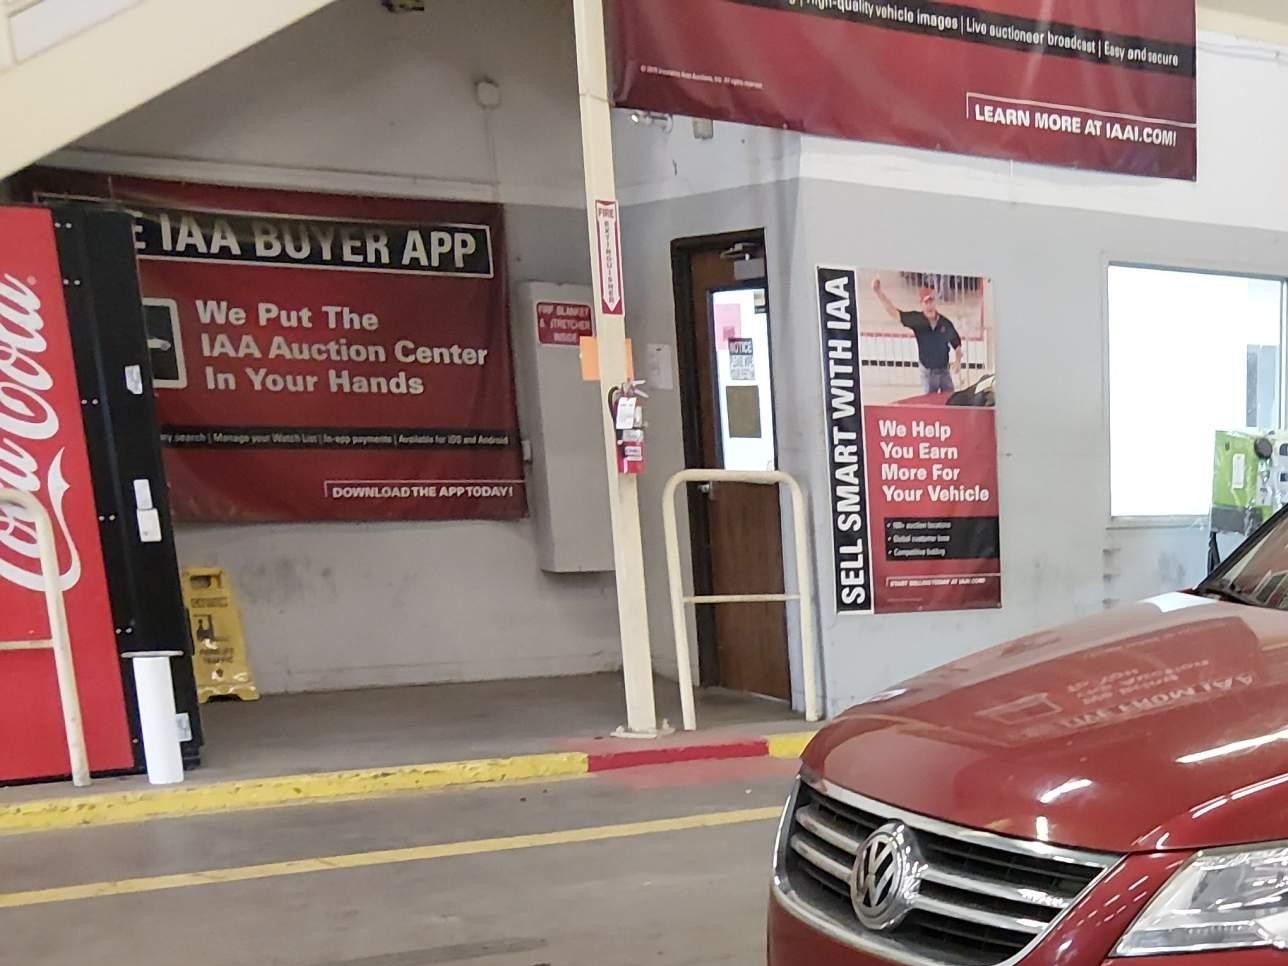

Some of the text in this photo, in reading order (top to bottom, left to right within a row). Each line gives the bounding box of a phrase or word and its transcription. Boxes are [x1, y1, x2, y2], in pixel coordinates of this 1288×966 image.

[876, 4, 914, 24] vehicle
[917, 9, 958, 31] images
[966, 17, 987, 35] Live
[989, 24, 1045, 46] auctioneer
[1047, 30, 1096, 54] broadcast
[1104, 41, 1125, 62] Easy
[1127, 46, 1147, 62] and
[1148, 50, 1179, 67] secure
[975, 103, 1177, 147] LEARN MORE AT IAAI.COM!
[160, 213, 242, 256] IAA
[251, 218, 391, 265] BUYER
[401, 229, 477, 269] APP
[195, 299, 379, 331] We Put The
[201, 332, 488, 367] IAA Auction Center
[205, 366, 424, 396] In Your Hands
[824, 275, 865, 605] SELL SMART WITH IAA
[878, 419, 951, 441] We Help
[879, 441, 958, 459] You Earn
[881, 463, 961, 481] More For
[332, 486, 513, 498] DOWNLOAD THE APP TODAY!
[881, 484, 990, 502] Your Vehicle
